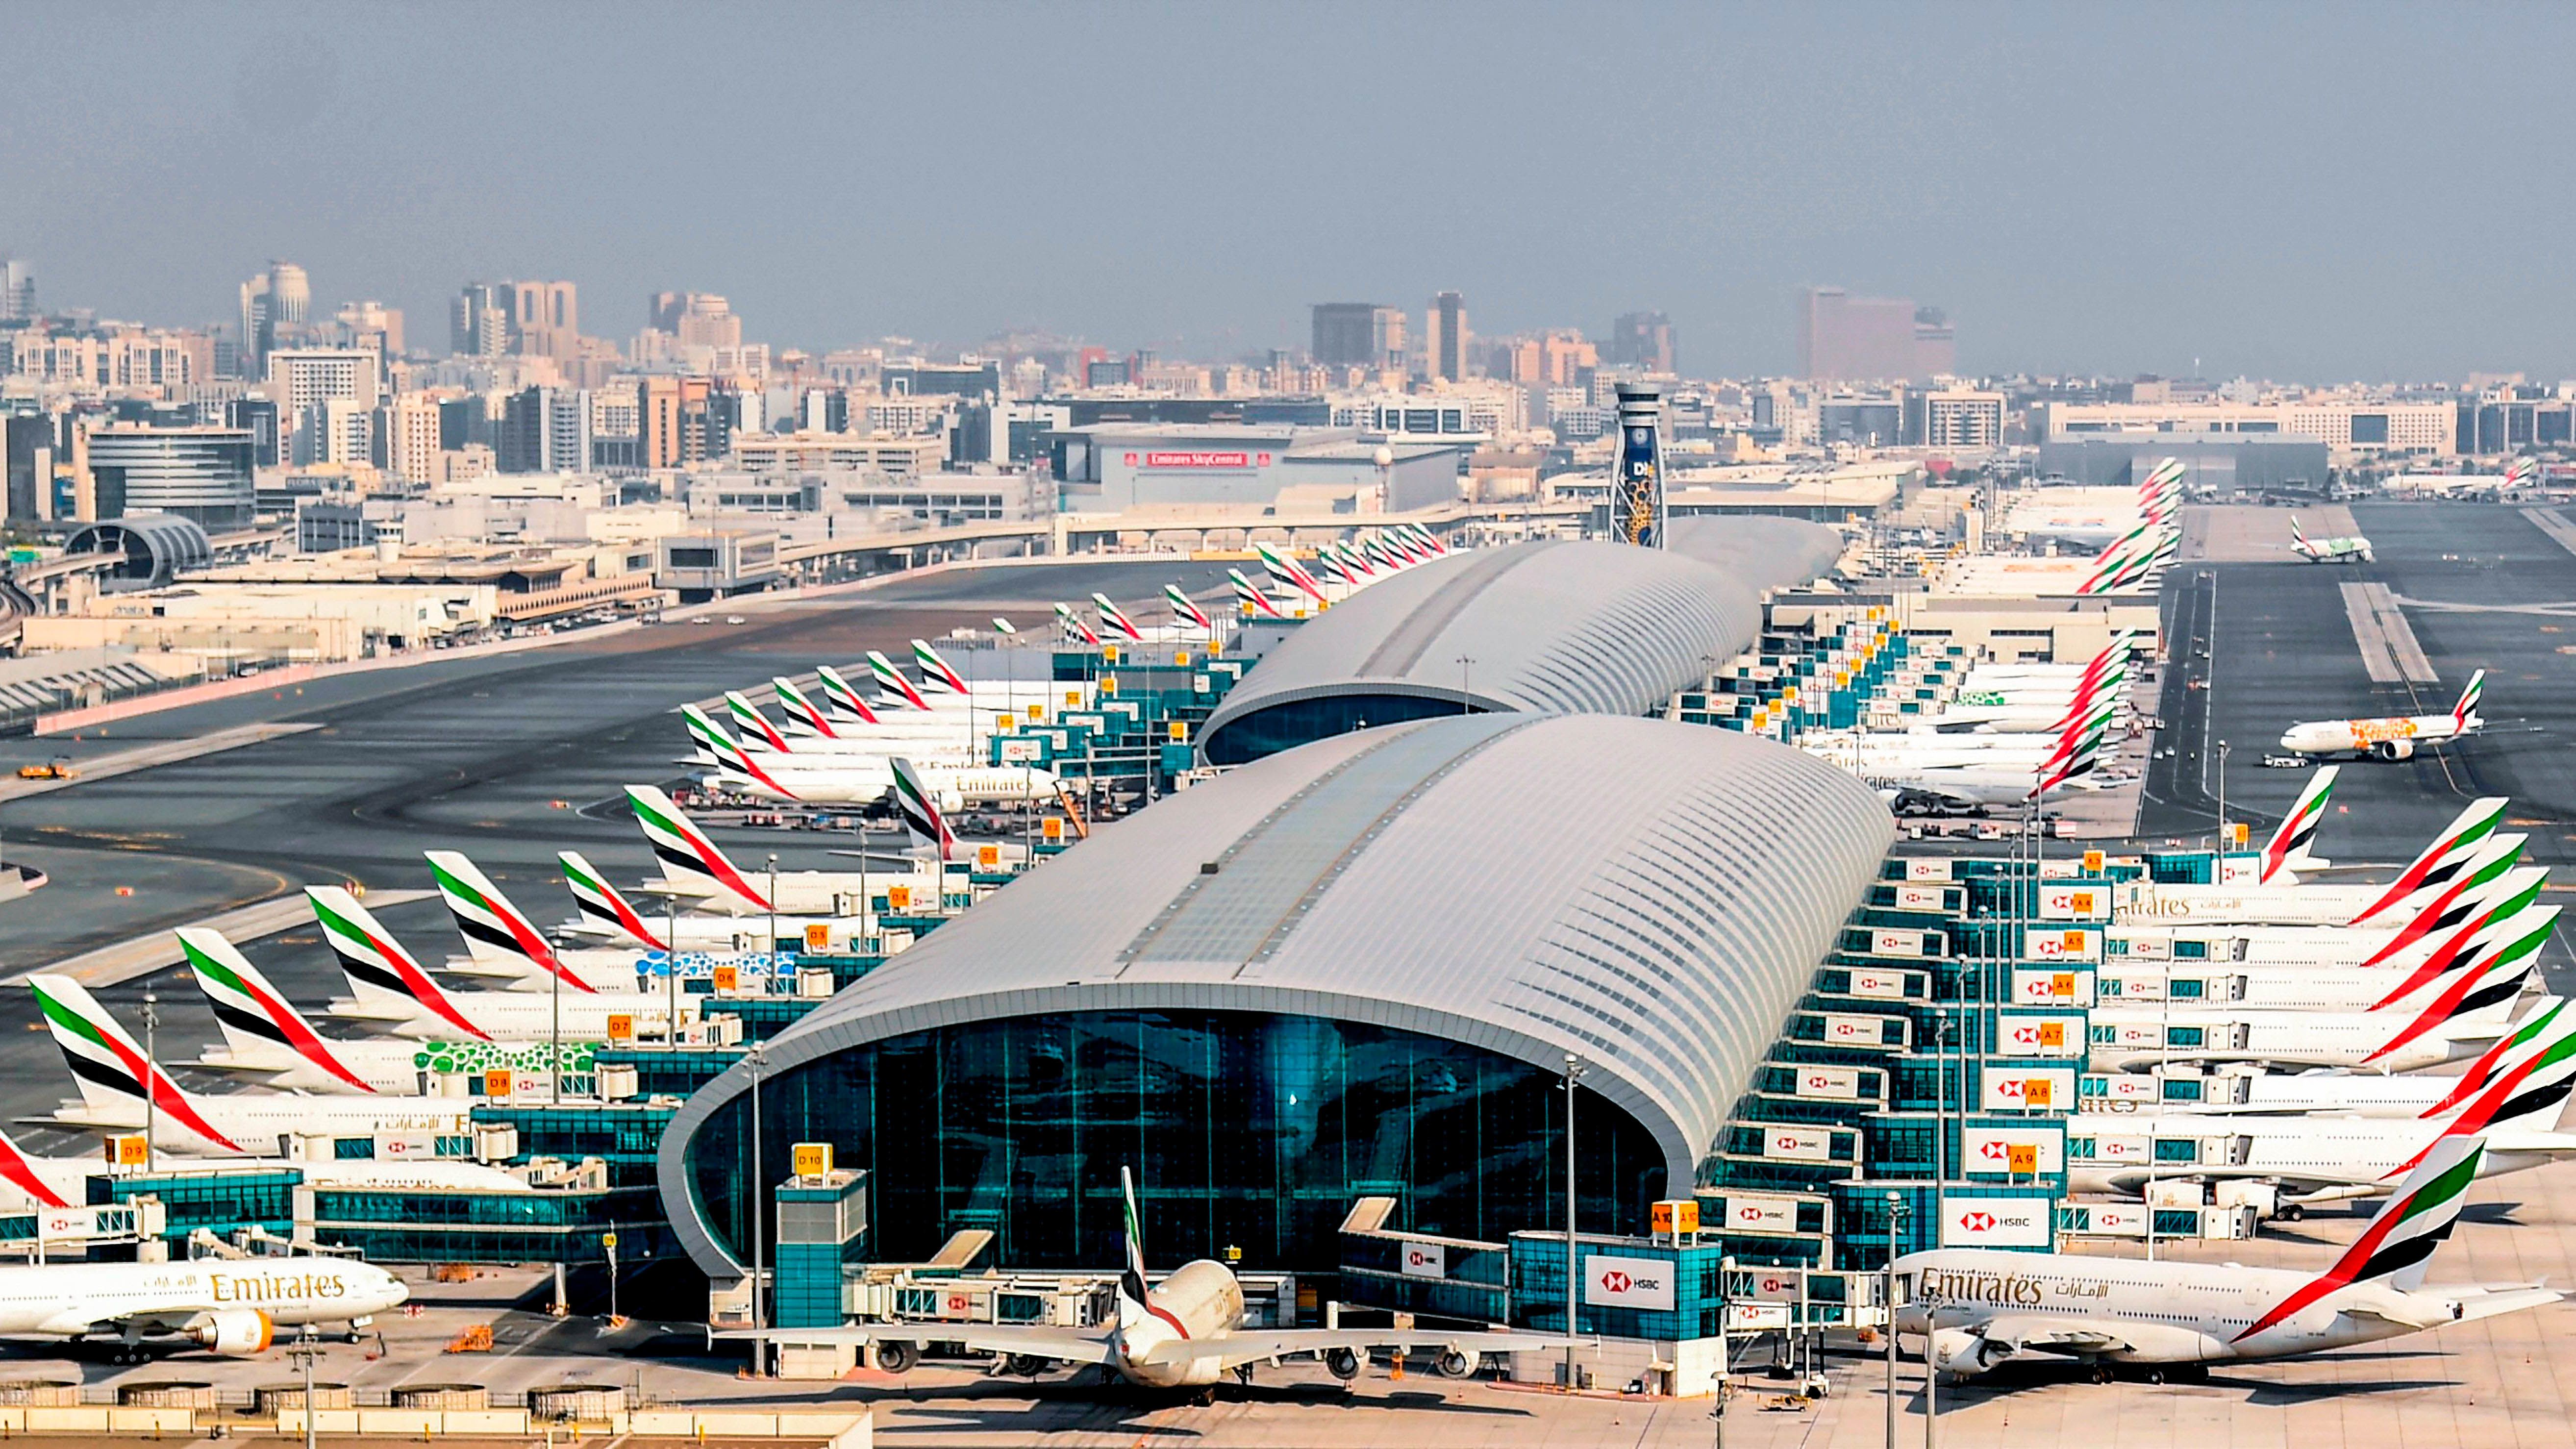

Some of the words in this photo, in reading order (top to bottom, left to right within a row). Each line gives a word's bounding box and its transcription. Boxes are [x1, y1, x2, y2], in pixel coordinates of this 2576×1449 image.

[1151, 453, 1190, 464] Emirates
[1192, 453, 1242, 466] SkyCentral
[612, 1022, 620, 1031] D
[490, 1078, 499, 1088] D
[2030, 1088, 2037, 1097] A
[2041, 1088, 2048, 1097] 8
[125, 1147, 133, 1157] D
[799, 1155, 806, 1165] D
[810, 1155, 821, 1165] 10
[2014, 1154, 2023, 1164] A
[2026, 1154, 2033, 1164] 9
[1652, 1211, 1660, 1223] A
[1680, 1212, 1687, 1223] A
[2000, 1218, 2030, 1227] HSBC
[209, 1272, 345, 1302] Emirates
[1634, 1279, 1659, 1290] HSBC
[1919, 1267, 2043, 1305] Emirates
[2055, 1280, 2109, 1300] الإمارات
